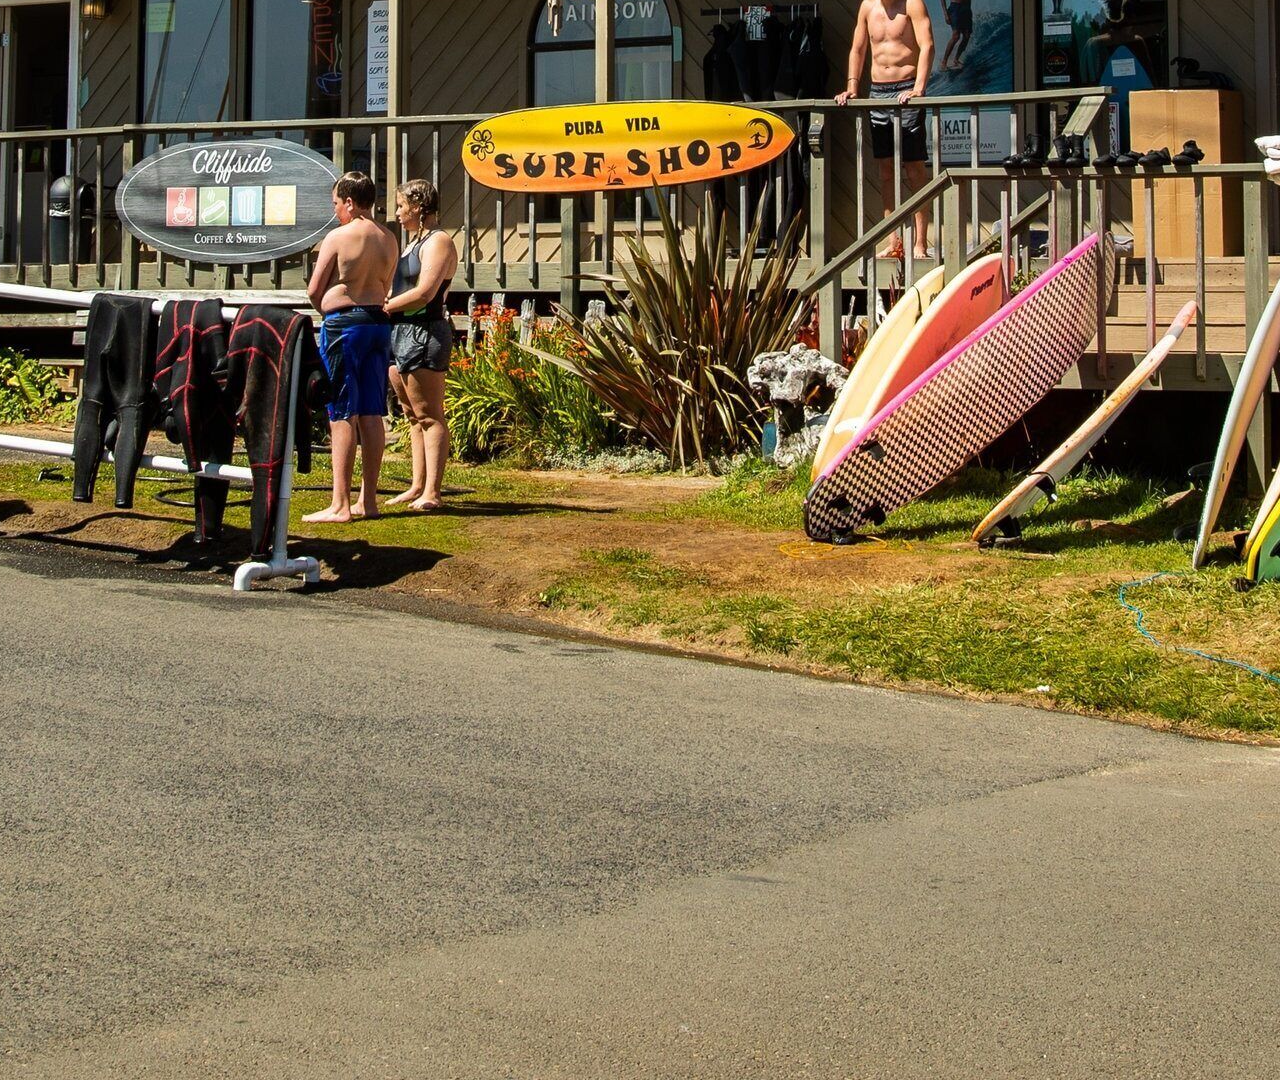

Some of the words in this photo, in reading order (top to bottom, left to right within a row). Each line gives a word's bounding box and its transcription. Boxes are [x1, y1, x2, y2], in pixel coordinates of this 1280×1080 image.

[565, 0, 656, 21] AINBOW
[564, 120, 604, 136] PURA
[625, 116, 661, 132] VIDA
[944, 120, 971, 135] KATI
[947, 142, 964, 151] SURF
[964, 142, 997, 150] COPANY
[192, 148, 273, 185] Cliffside
[494, 151, 606, 179] SURF
[627, 139, 741, 177] SHOP
[194, 233, 224, 244] COFFEE
[226, 233, 234, 244] &
[236, 232, 267, 244] SWEETS
